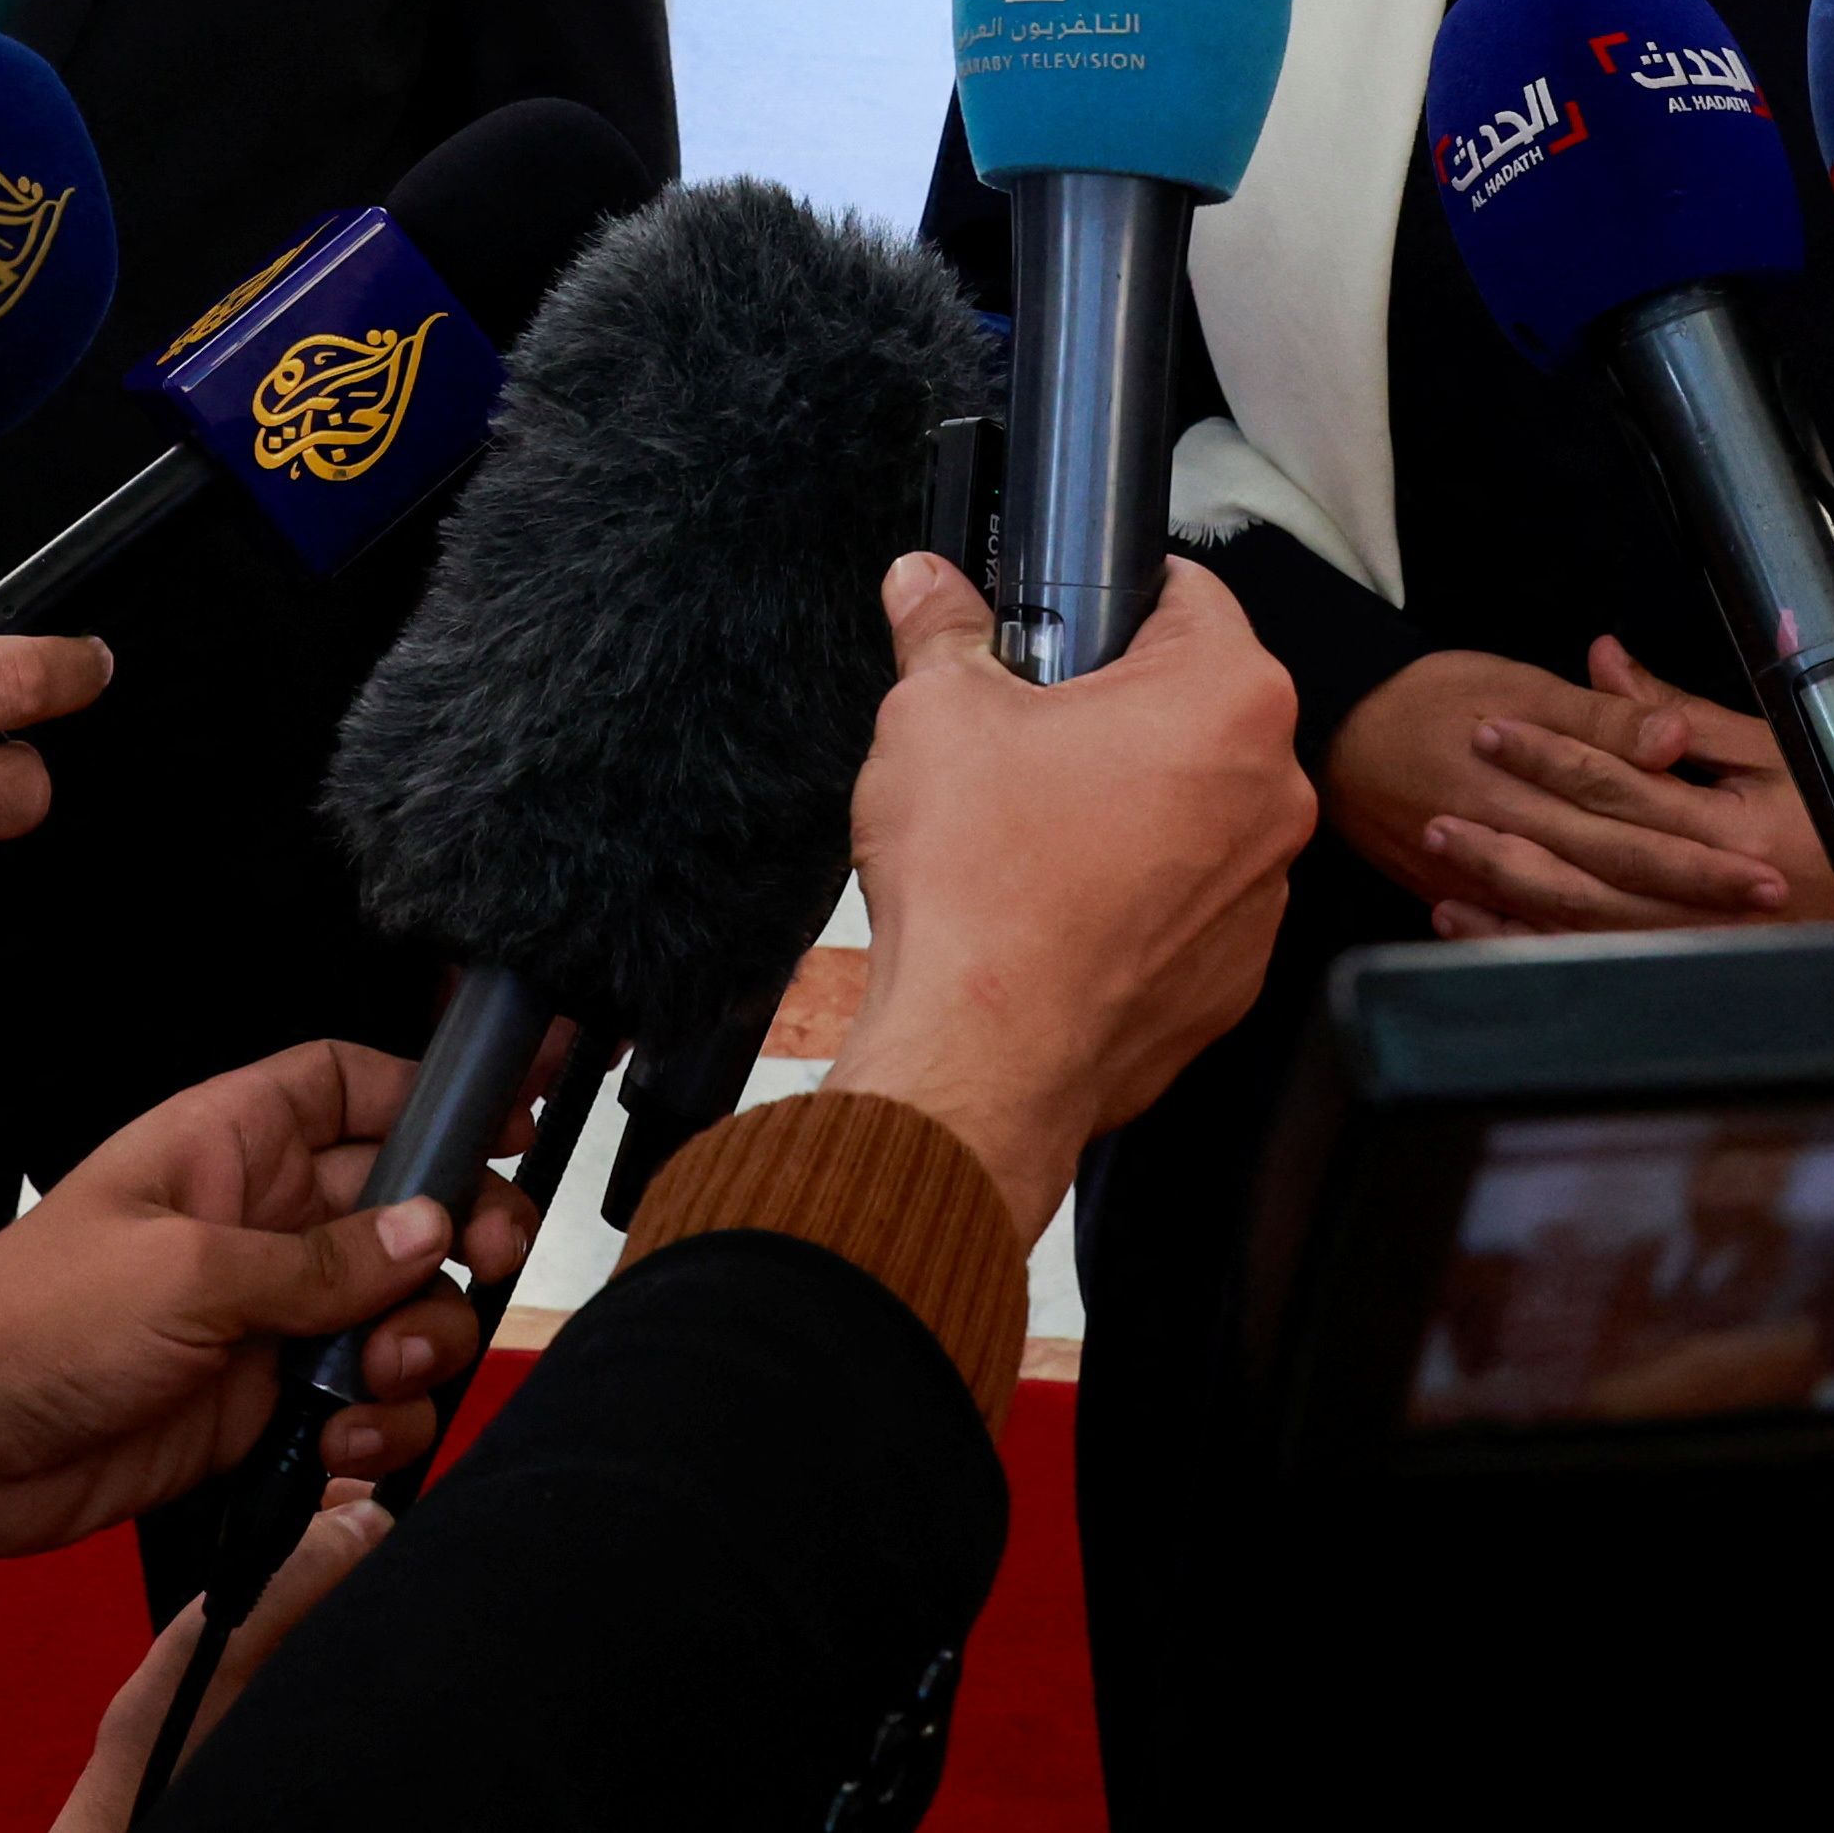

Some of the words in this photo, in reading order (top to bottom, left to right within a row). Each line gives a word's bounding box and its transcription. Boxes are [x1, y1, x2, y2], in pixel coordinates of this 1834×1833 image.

[1010, 13, 1141, 42] التلفزيون
[1021, 52, 1146, 71] TELEVISION
[1631, 41, 1755, 93] الحدث
[1668, 96, 1692, 113] AL
[1692, 95, 1752, 114] HADATH
[1451, 77, 1559, 191] الحدث
[1471, 190, 1487, 213] AL
[1484, 146, 1545, 197] HADATH
[984, 513, 1000, 590] BOYA
